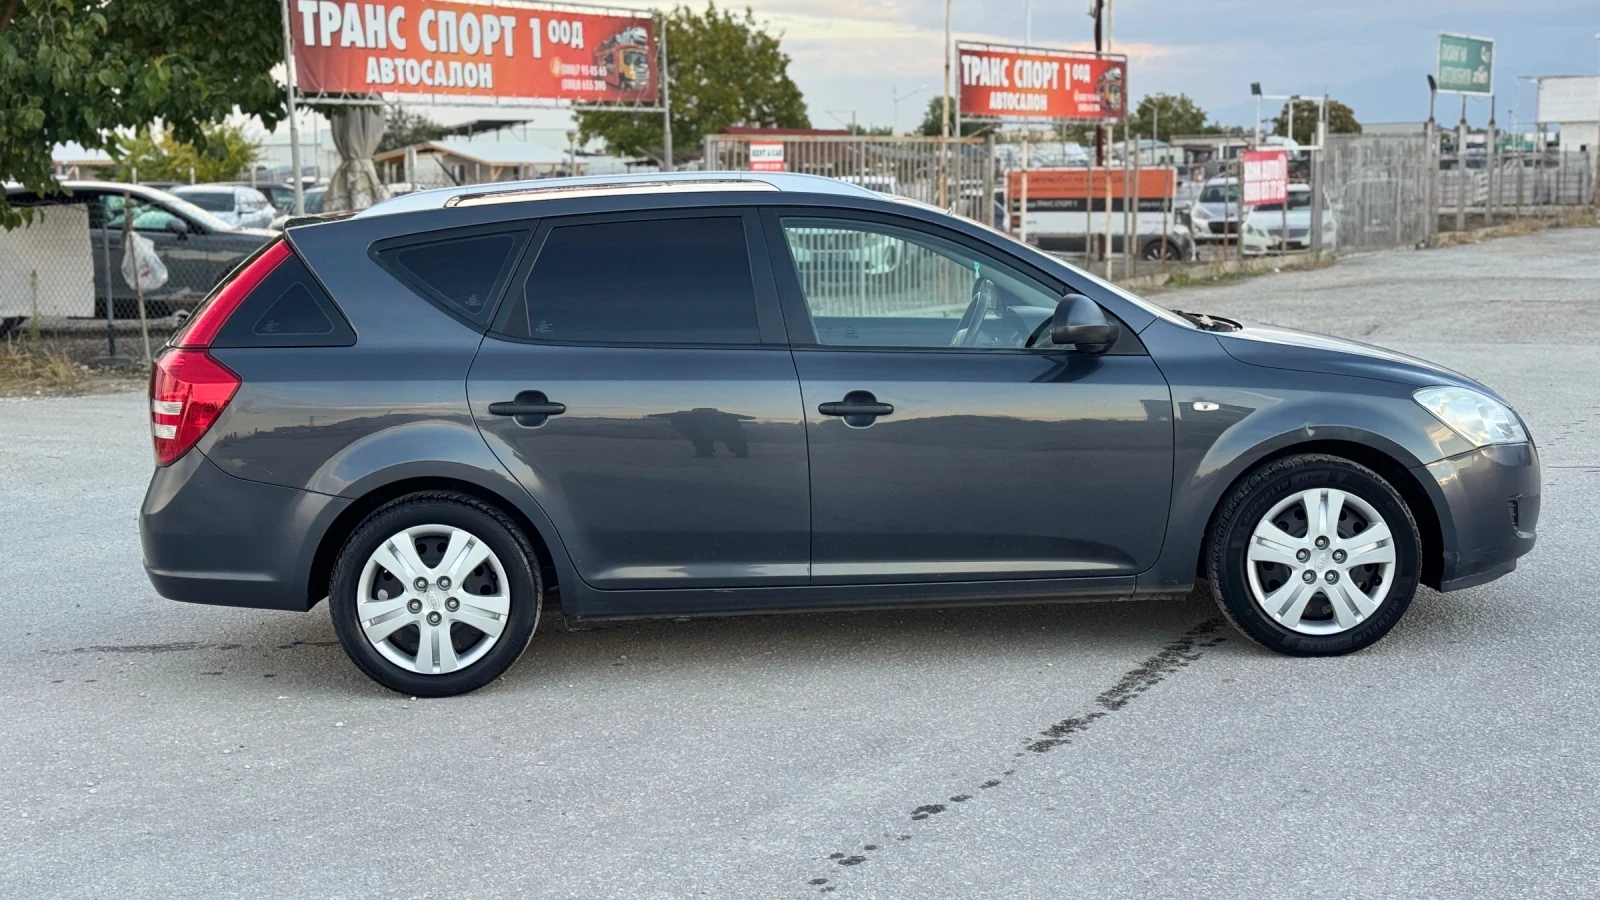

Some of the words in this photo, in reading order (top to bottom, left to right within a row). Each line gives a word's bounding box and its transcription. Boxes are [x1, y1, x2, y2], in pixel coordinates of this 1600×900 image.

[298, 0, 406, 51] ТРАНС
[418, 8, 516, 57] СПОРТ
[530, 18, 543, 59] 1
[547, 19, 585, 49] ООД
[366, 56, 493, 89] АВТОСАЛОН
[961, 55, 1010, 88] ТРАНС
[1014, 59, 1060, 90] СПОРТ
[1064, 63, 1071, 91] 1
[1072, 63, 1091, 83] ООД
[989, 91, 1048, 112] АВТОСАЛОН
